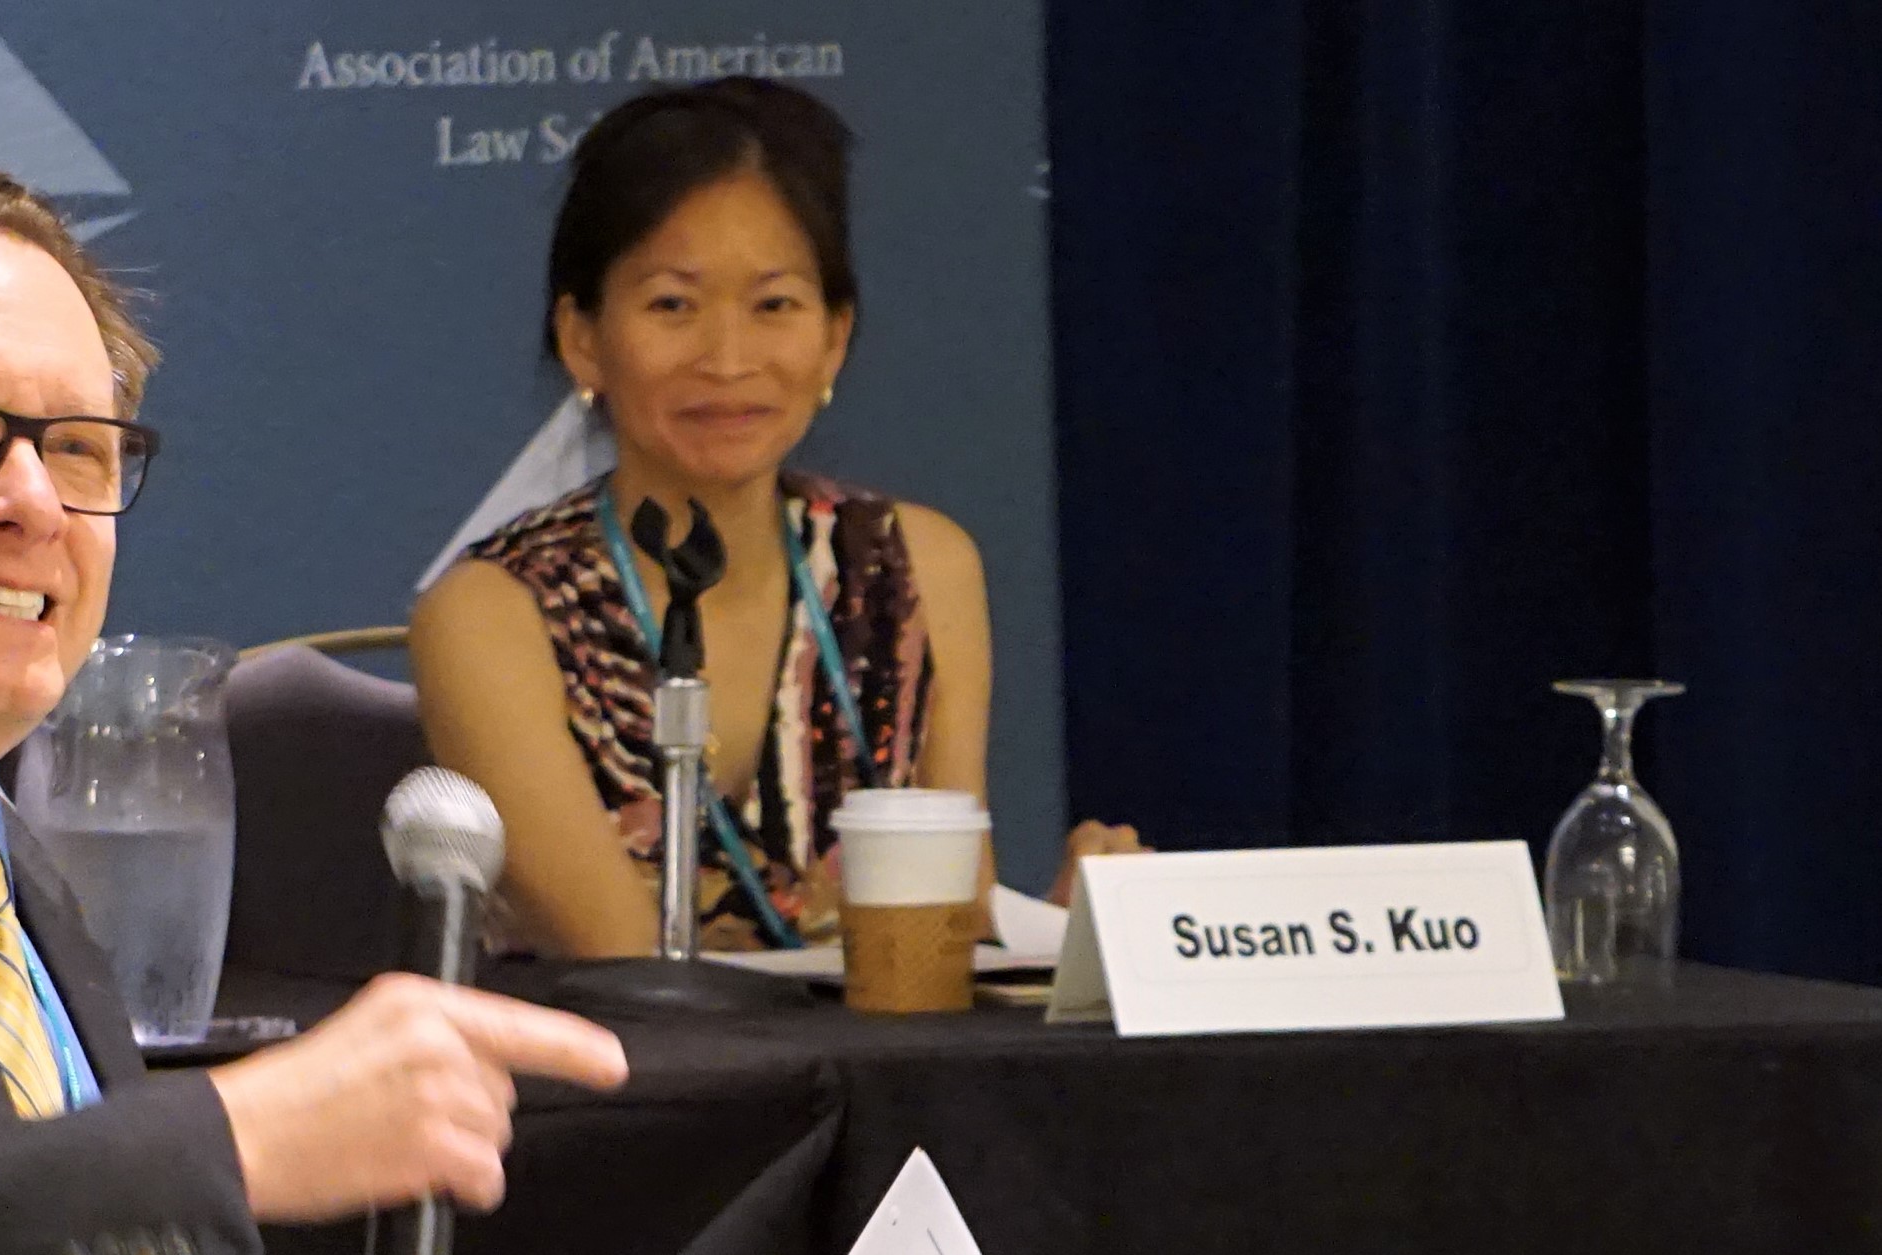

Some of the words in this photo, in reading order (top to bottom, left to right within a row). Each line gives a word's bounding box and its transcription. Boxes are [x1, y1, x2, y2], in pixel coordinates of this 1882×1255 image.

[297, 39, 558, 89] Association
[568, 29, 622, 82] of
[626, 31, 844, 82] American
[434, 115, 529, 165] Law
[1171, 911, 1317, 959] Susan
[1328, 909, 1375, 955] S.
[1387, 906, 1482, 952] Kuo
